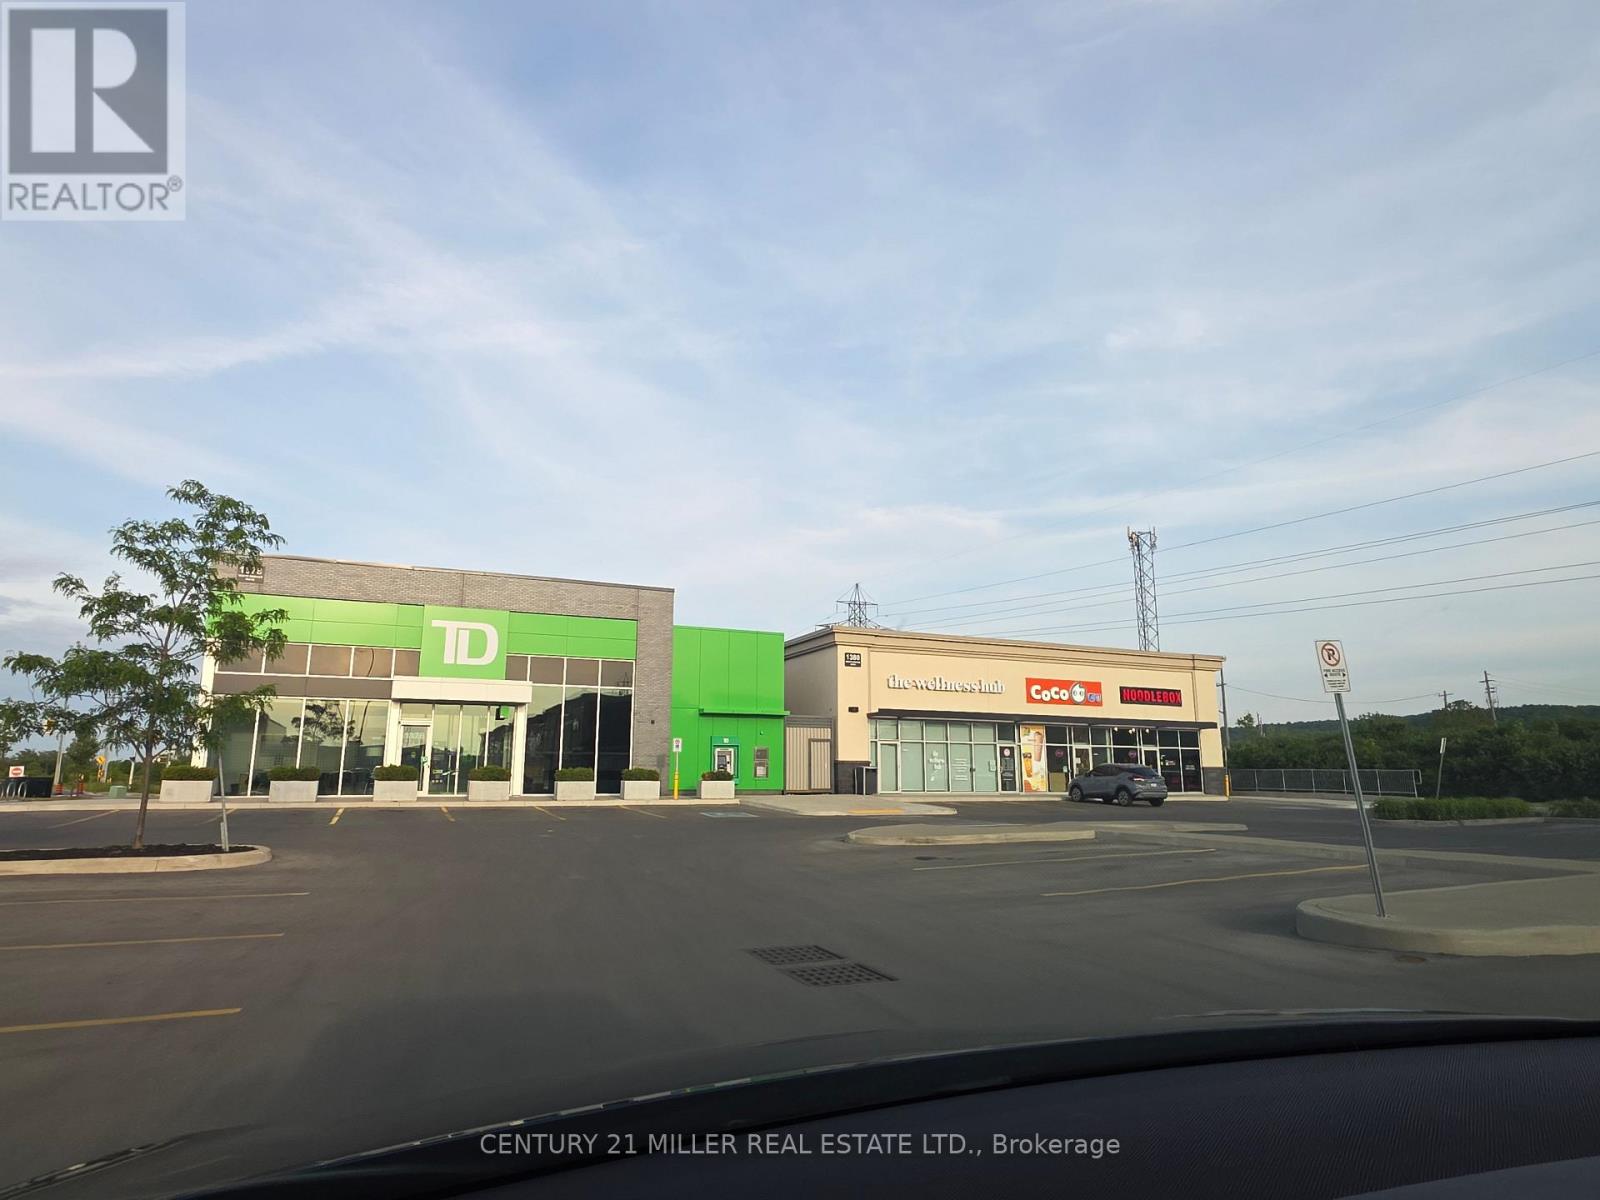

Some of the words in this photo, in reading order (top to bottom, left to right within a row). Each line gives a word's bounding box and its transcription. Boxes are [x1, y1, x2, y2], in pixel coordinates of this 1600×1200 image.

[431, 619, 499, 666] TD
[887, 674, 911, 690] the
[914, 677, 977, 693] wellness
[979, 679, 1005, 695] hub
[1123, 688, 1181, 704] NOODLEBOX
